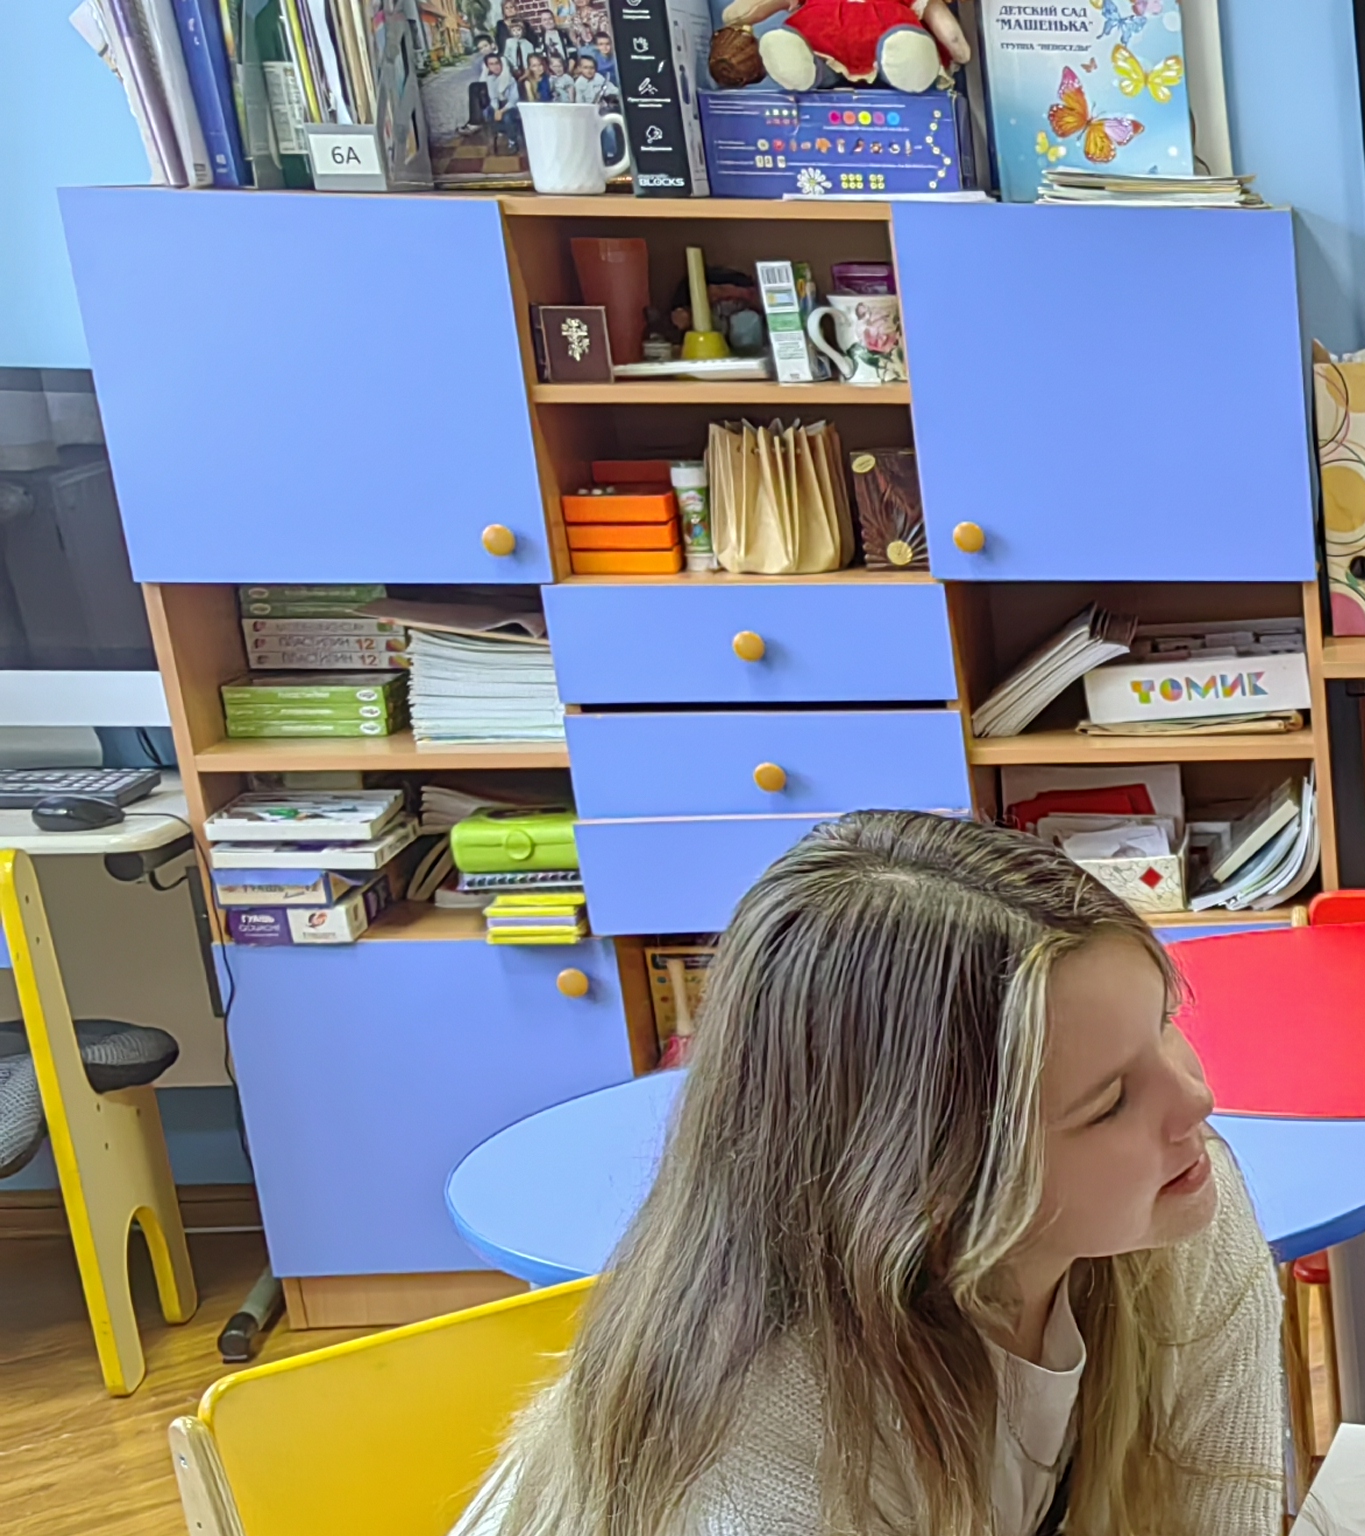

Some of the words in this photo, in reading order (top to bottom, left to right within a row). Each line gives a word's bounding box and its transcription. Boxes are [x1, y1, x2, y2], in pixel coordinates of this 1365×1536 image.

[999, 5, 1058, 17] ДЕТСКИЙ
[1061, 7, 1088, 18] САД
[356, 638, 376, 651] 12
[360, 654, 378, 667] 12
[1130, 671, 1269, 704] ТОМИК
